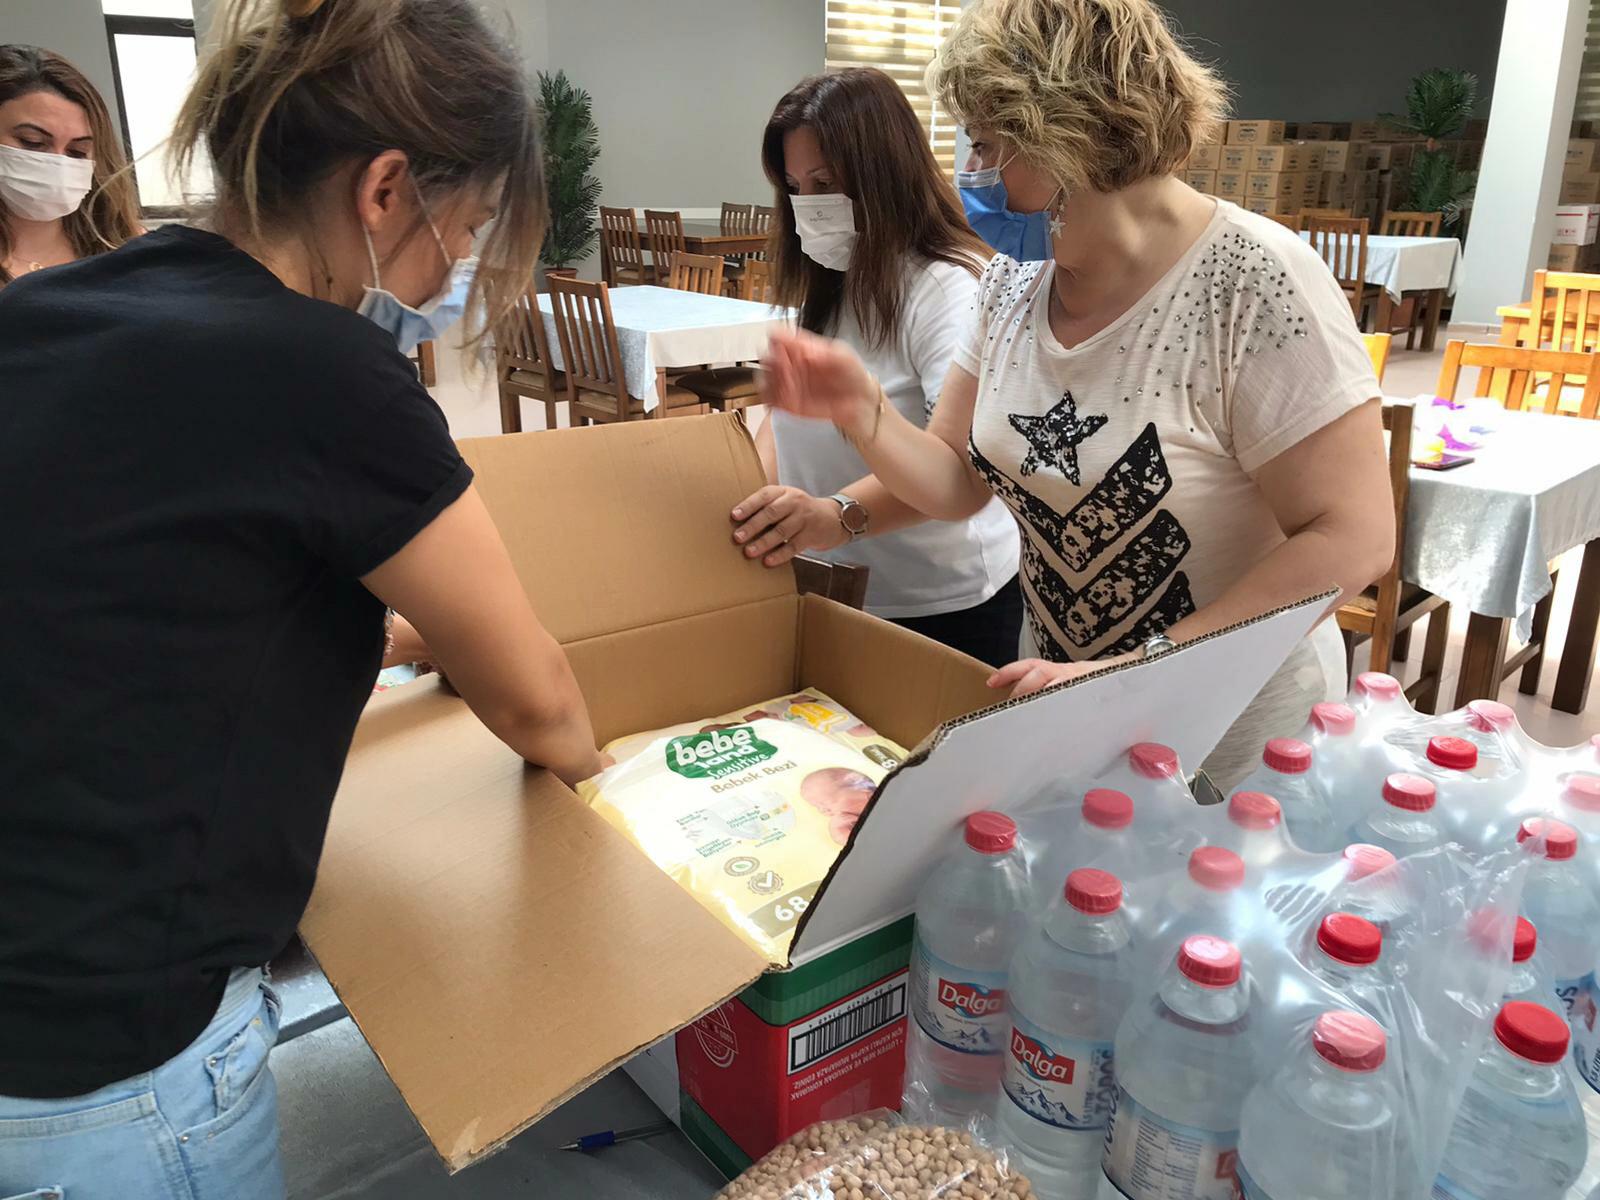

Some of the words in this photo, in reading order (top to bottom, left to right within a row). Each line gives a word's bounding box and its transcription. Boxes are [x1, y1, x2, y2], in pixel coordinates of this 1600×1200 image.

[673, 730, 752, 766] bebe
[711, 755, 769, 779] Sensitive
[711, 772, 762, 793] Bebek
[764, 760, 796, 776] Bezi
[774, 896, 810, 921] 68
[941, 983, 1001, 1016] Dalga
[1012, 1034, 1069, 1080] Dalga
